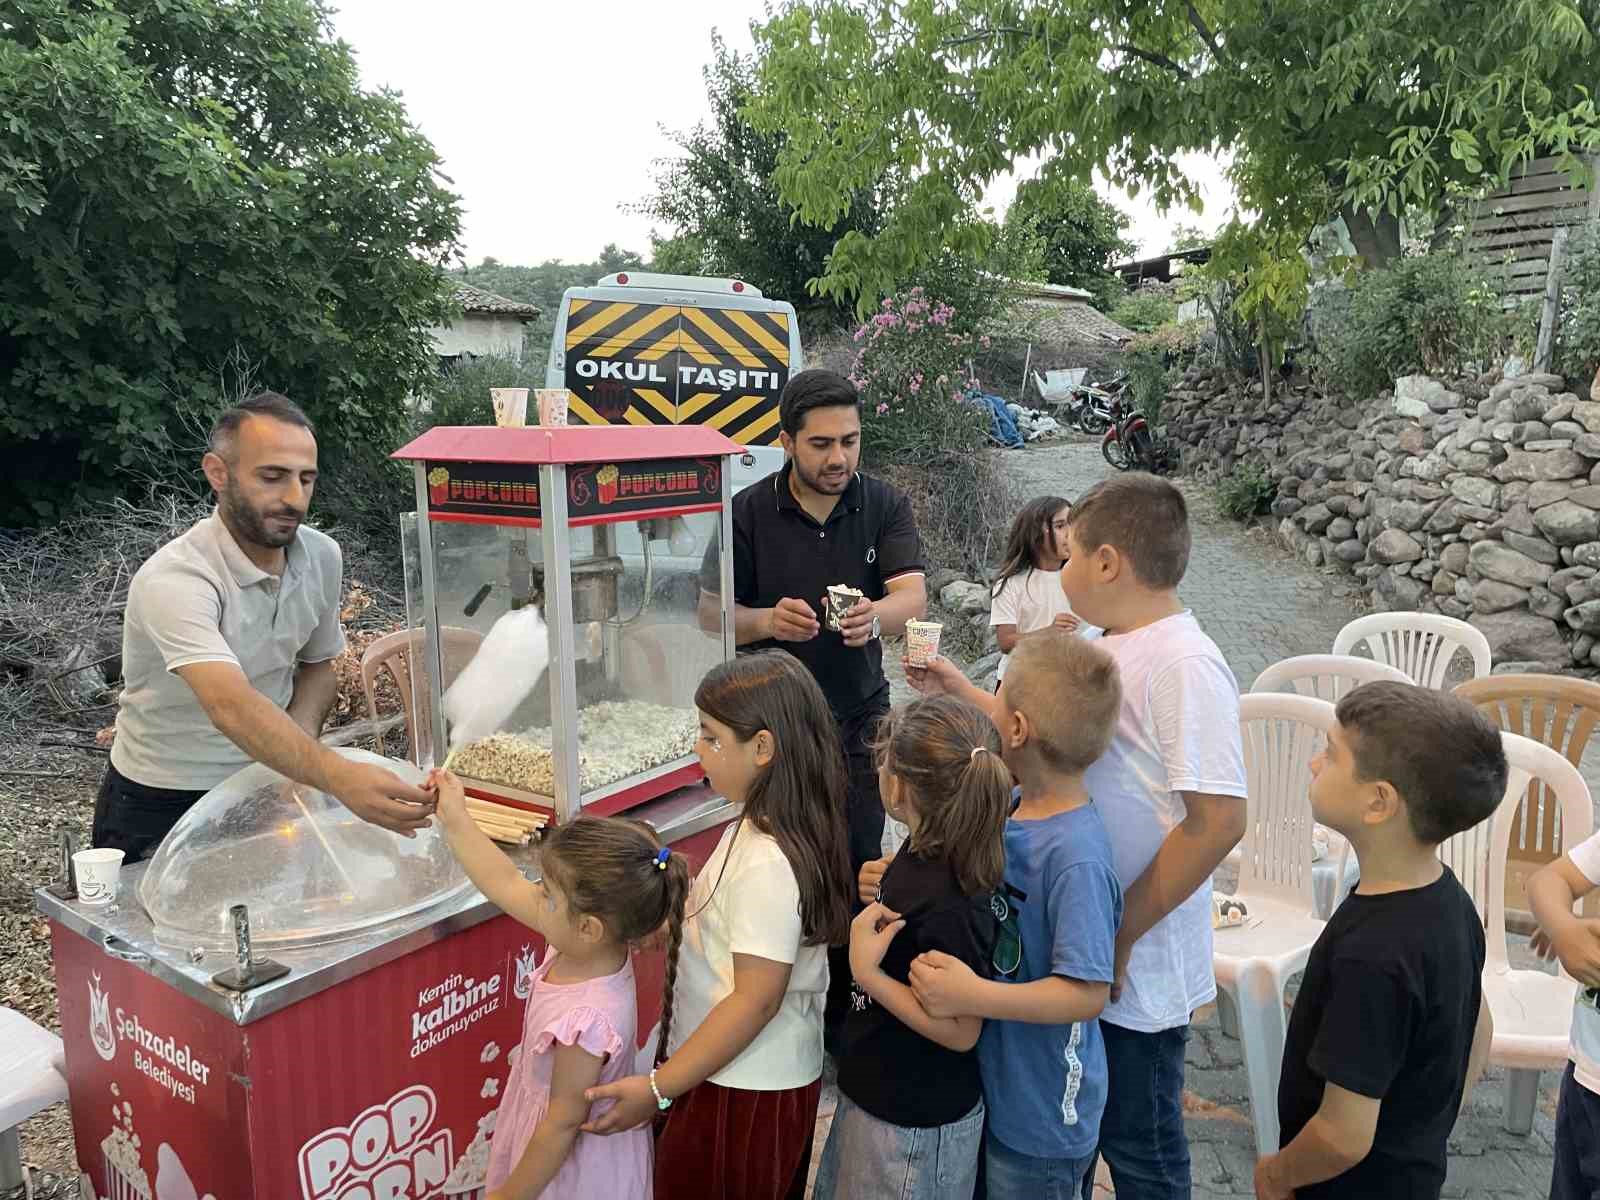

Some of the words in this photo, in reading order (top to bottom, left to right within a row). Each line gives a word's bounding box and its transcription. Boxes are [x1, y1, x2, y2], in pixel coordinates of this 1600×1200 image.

[575, 359, 667, 383] OKUL
[678, 366, 779, 391] TAŞITI
[450, 480, 537, 503] POPCORN
[620, 471, 698, 495] POPCORN
[412, 974, 501, 1040] kalbine
[418, 973, 463, 1007] Kentin
[115, 1007, 210, 1086] Şehzadeler
[410, 998, 500, 1058] dokunuyoruz
[134, 1049, 195, 1105] Belediyesi
[304, 1091, 432, 1196] POP
